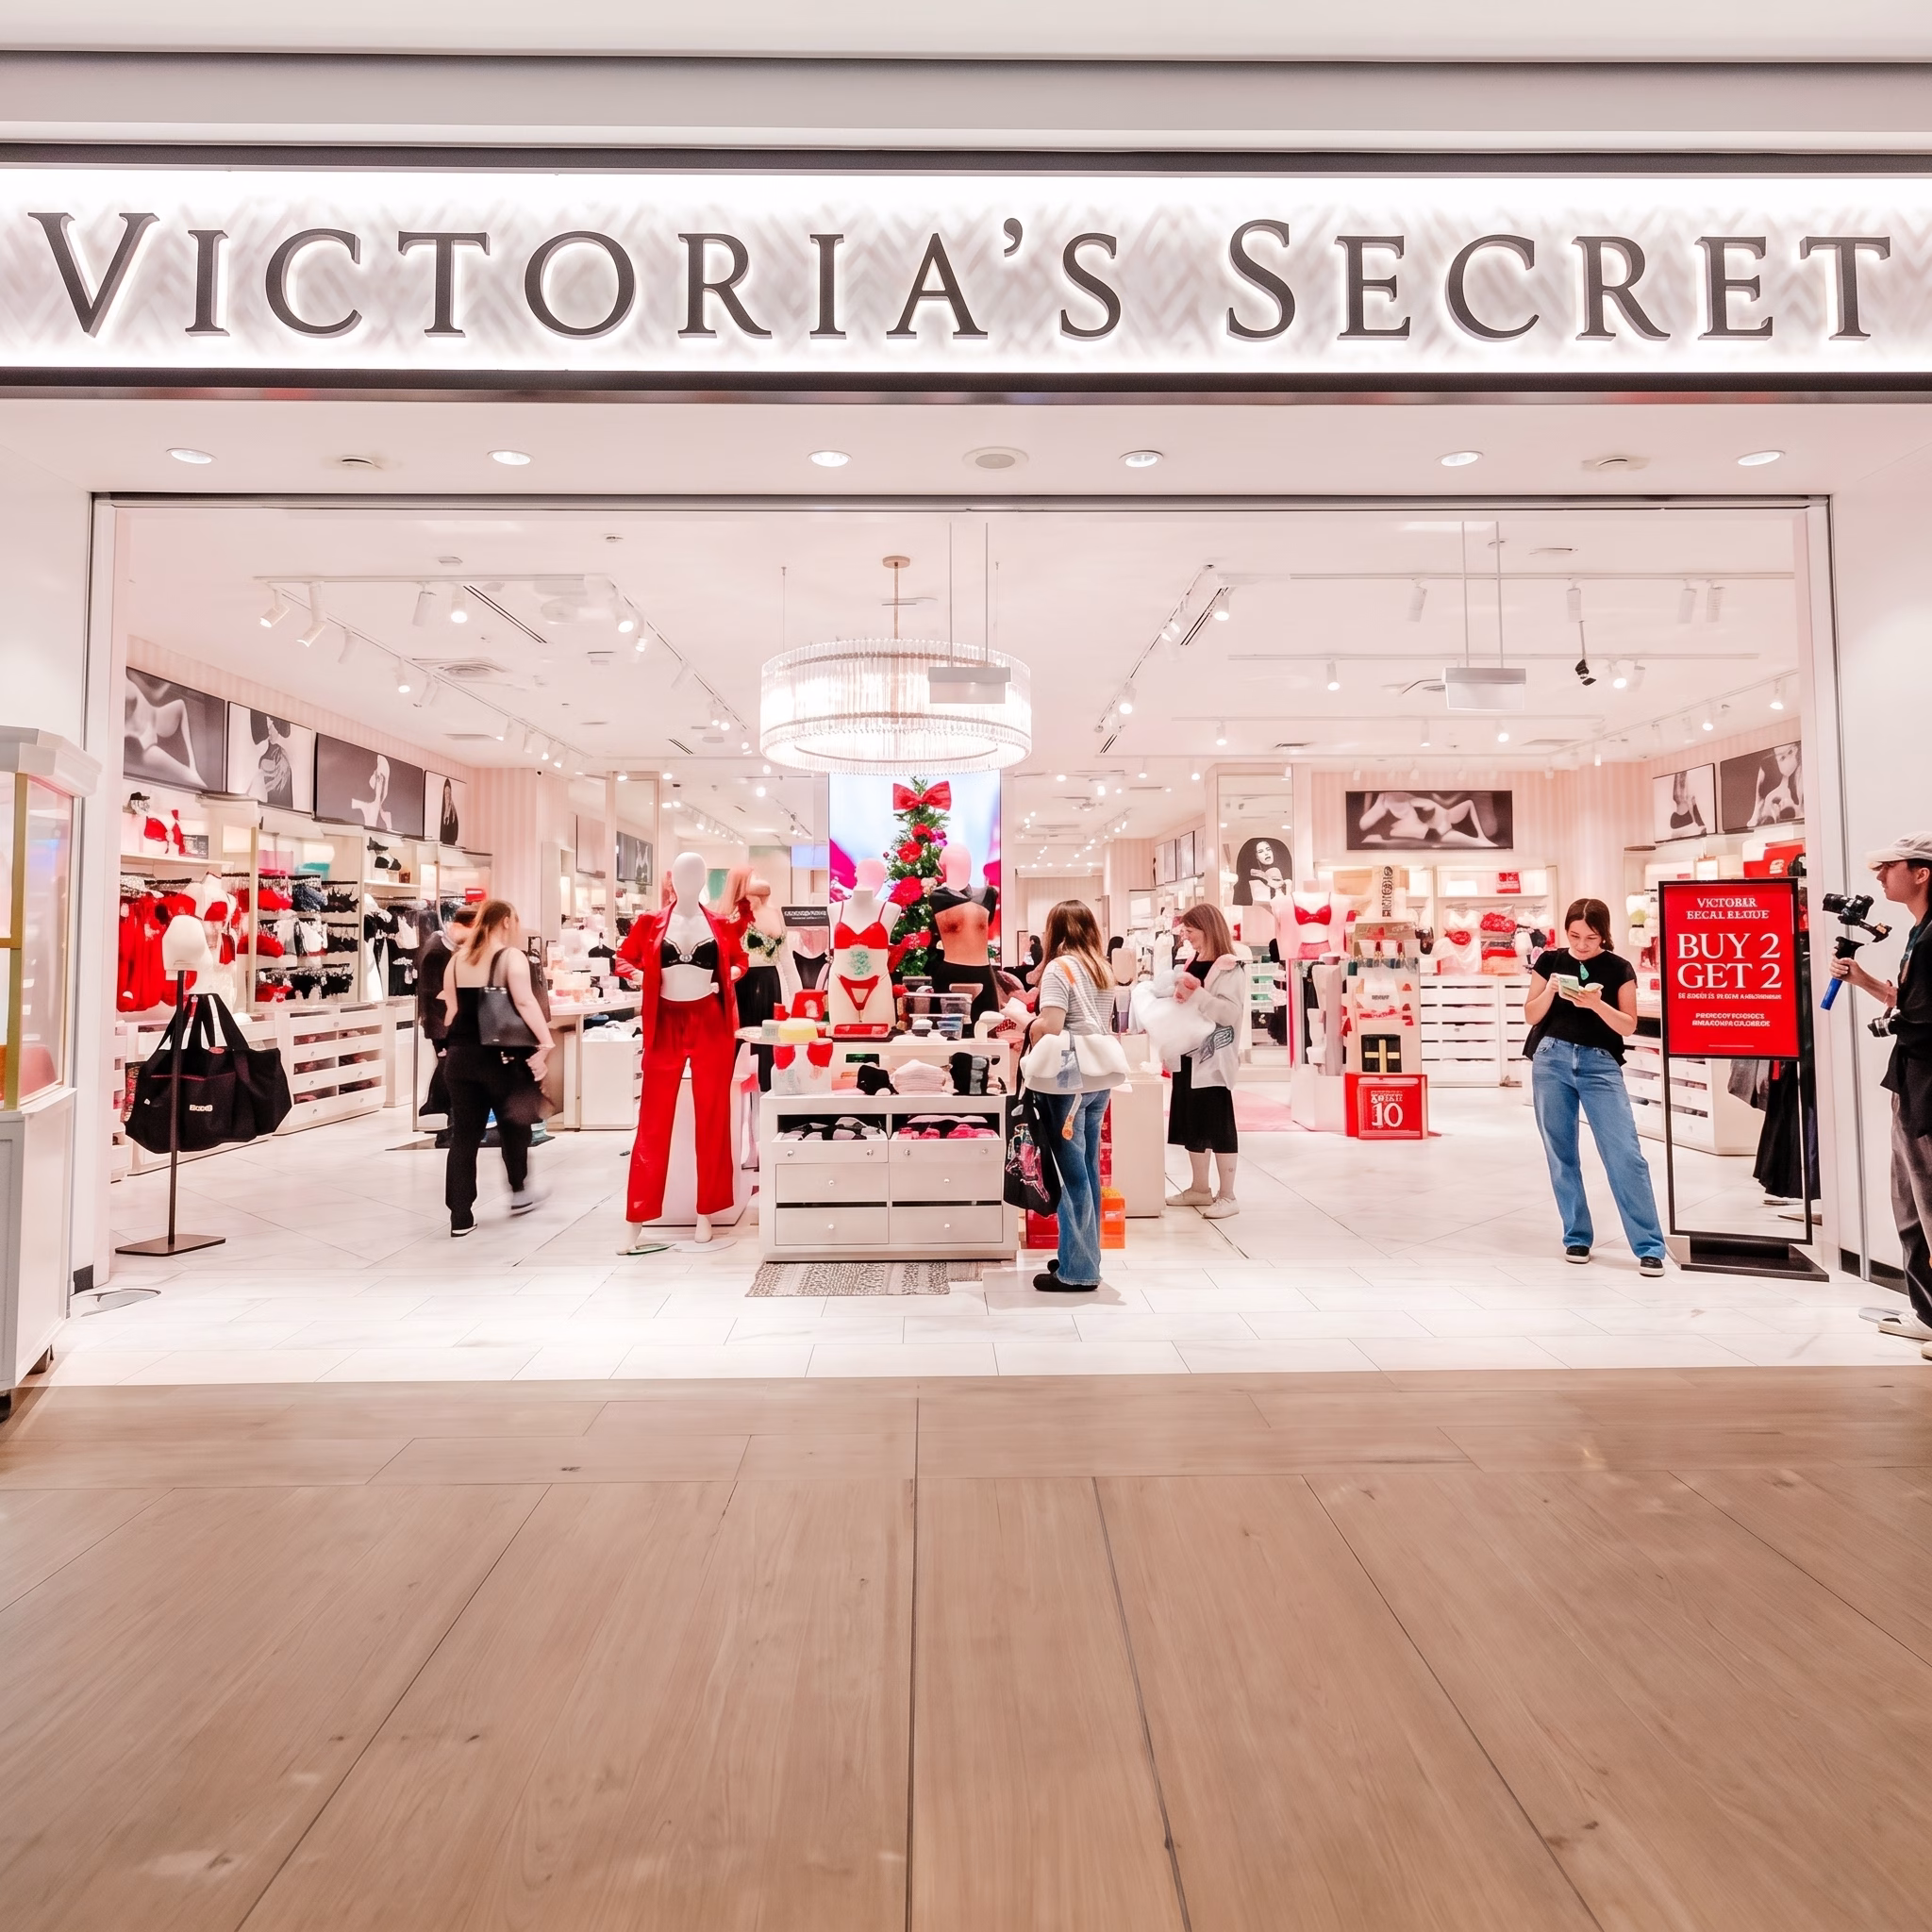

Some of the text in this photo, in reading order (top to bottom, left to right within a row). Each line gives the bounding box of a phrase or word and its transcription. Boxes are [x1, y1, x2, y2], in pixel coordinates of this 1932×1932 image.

[28, 211, 1890, 341] VICTORIA'S SECRET
[1676, 933, 1781, 959] BUY 2
[1676, 962, 1782, 989] GET 2
[1372, 1103, 1404, 1127] 10
